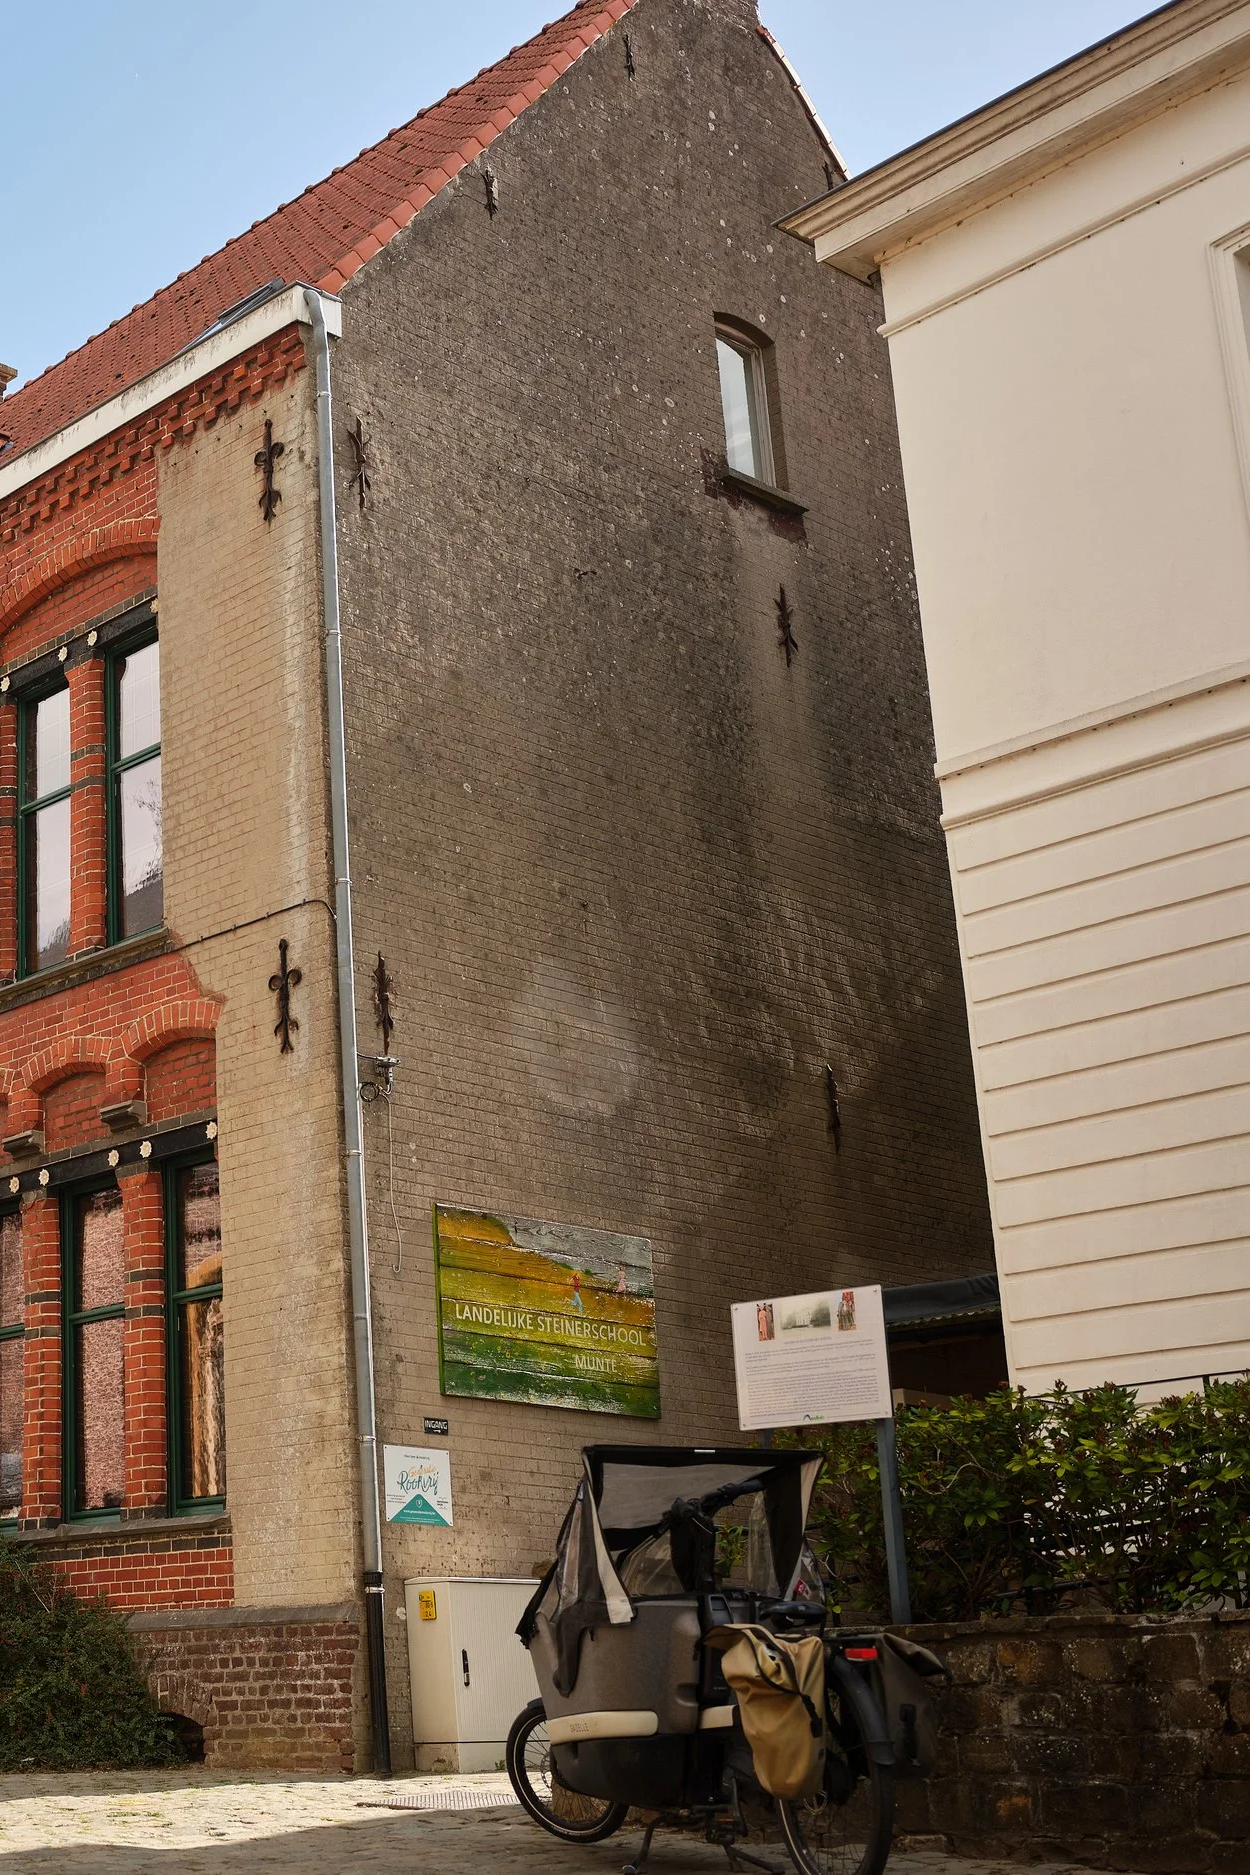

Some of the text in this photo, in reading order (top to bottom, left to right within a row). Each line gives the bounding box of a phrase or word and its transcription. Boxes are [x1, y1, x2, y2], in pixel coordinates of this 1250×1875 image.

[455, 1304, 646, 1346] LANDELIJKE STEINERSCHOOL
[575, 1354, 618, 1373] MUNTE
[425, 1420, 447, 1430] INGANG
[397, 1466, 439, 1495] Rookvrij
